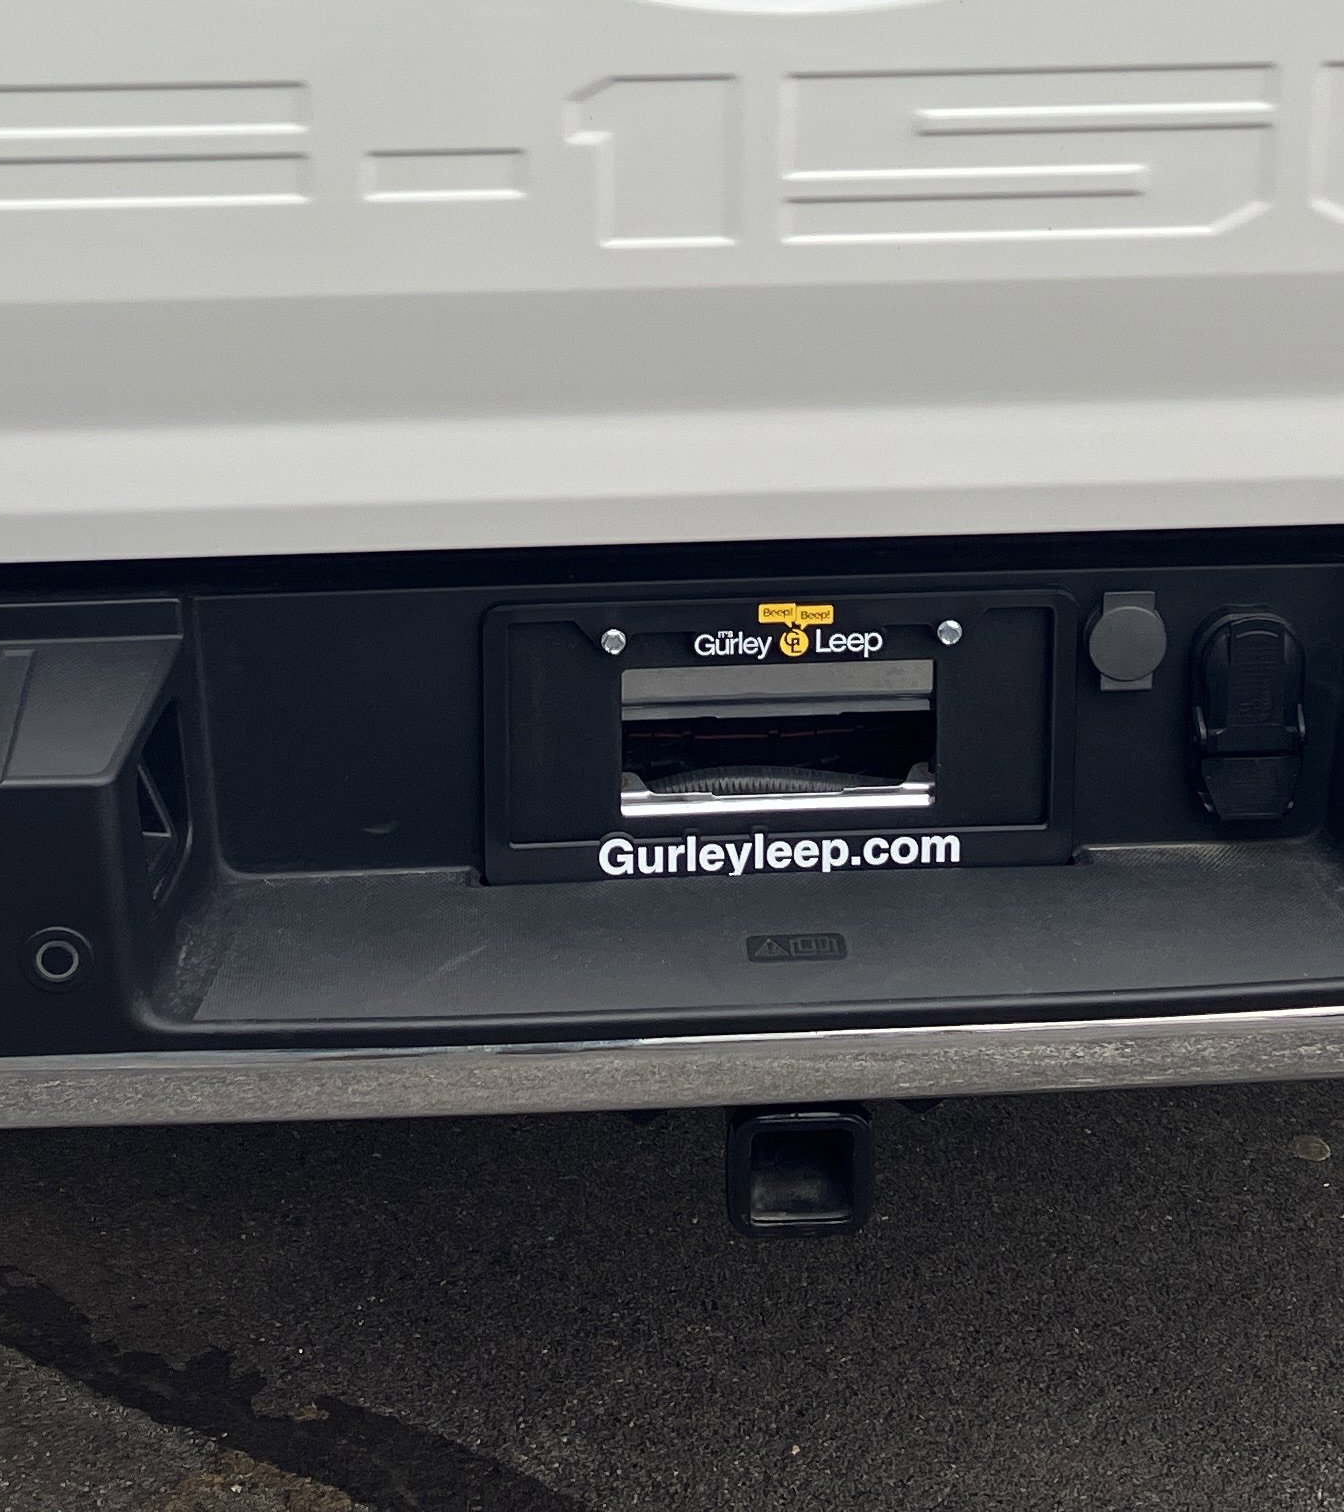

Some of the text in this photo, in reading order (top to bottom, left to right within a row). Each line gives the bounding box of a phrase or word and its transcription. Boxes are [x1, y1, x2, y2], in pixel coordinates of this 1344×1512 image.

[763, 608, 831, 621] Beep! Beep!
[694, 631, 772, 660] Gurley
[815, 629, 883, 658] Leep
[598, 833, 961, 876] Gurleyleep.com
